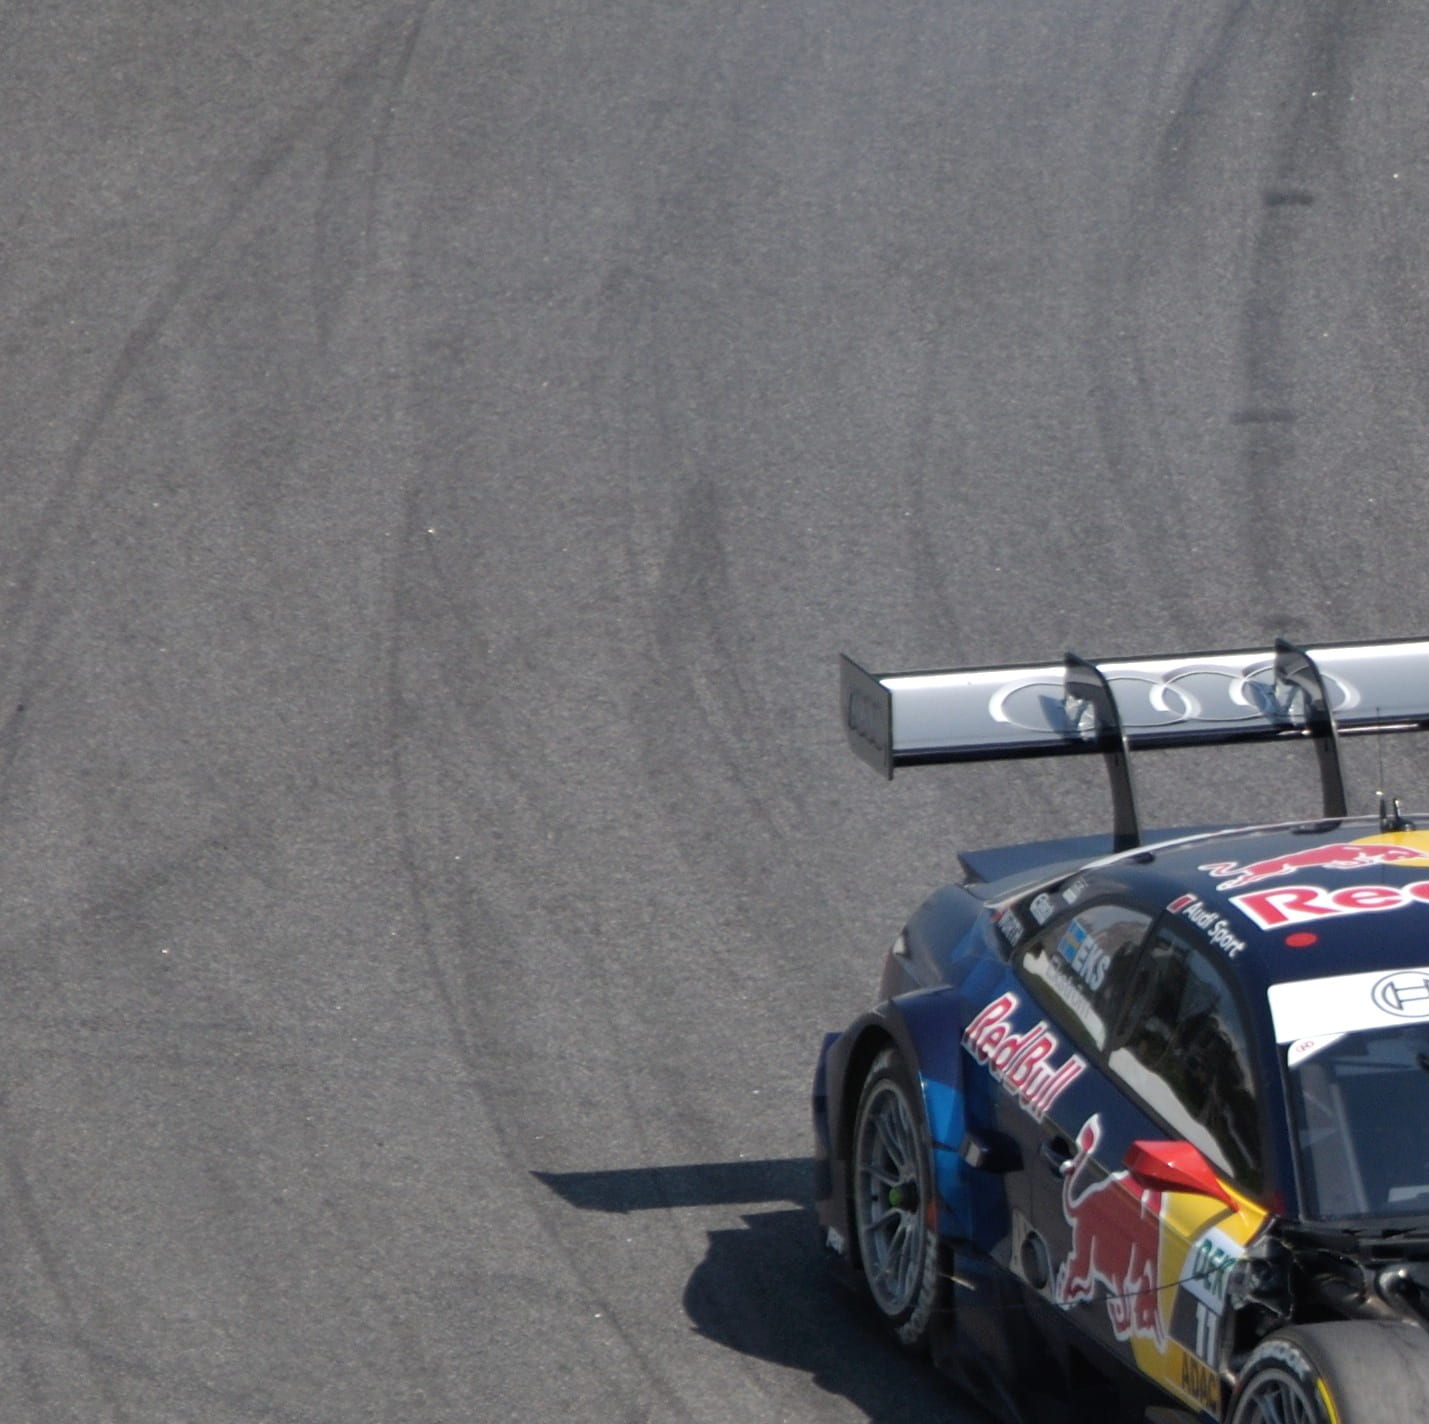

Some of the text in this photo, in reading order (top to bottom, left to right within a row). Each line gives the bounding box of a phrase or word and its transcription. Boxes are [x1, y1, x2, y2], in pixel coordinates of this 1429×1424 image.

[1182, 901, 1246, 958] Audi Sport
[1071, 934, 1112, 992] EKS
